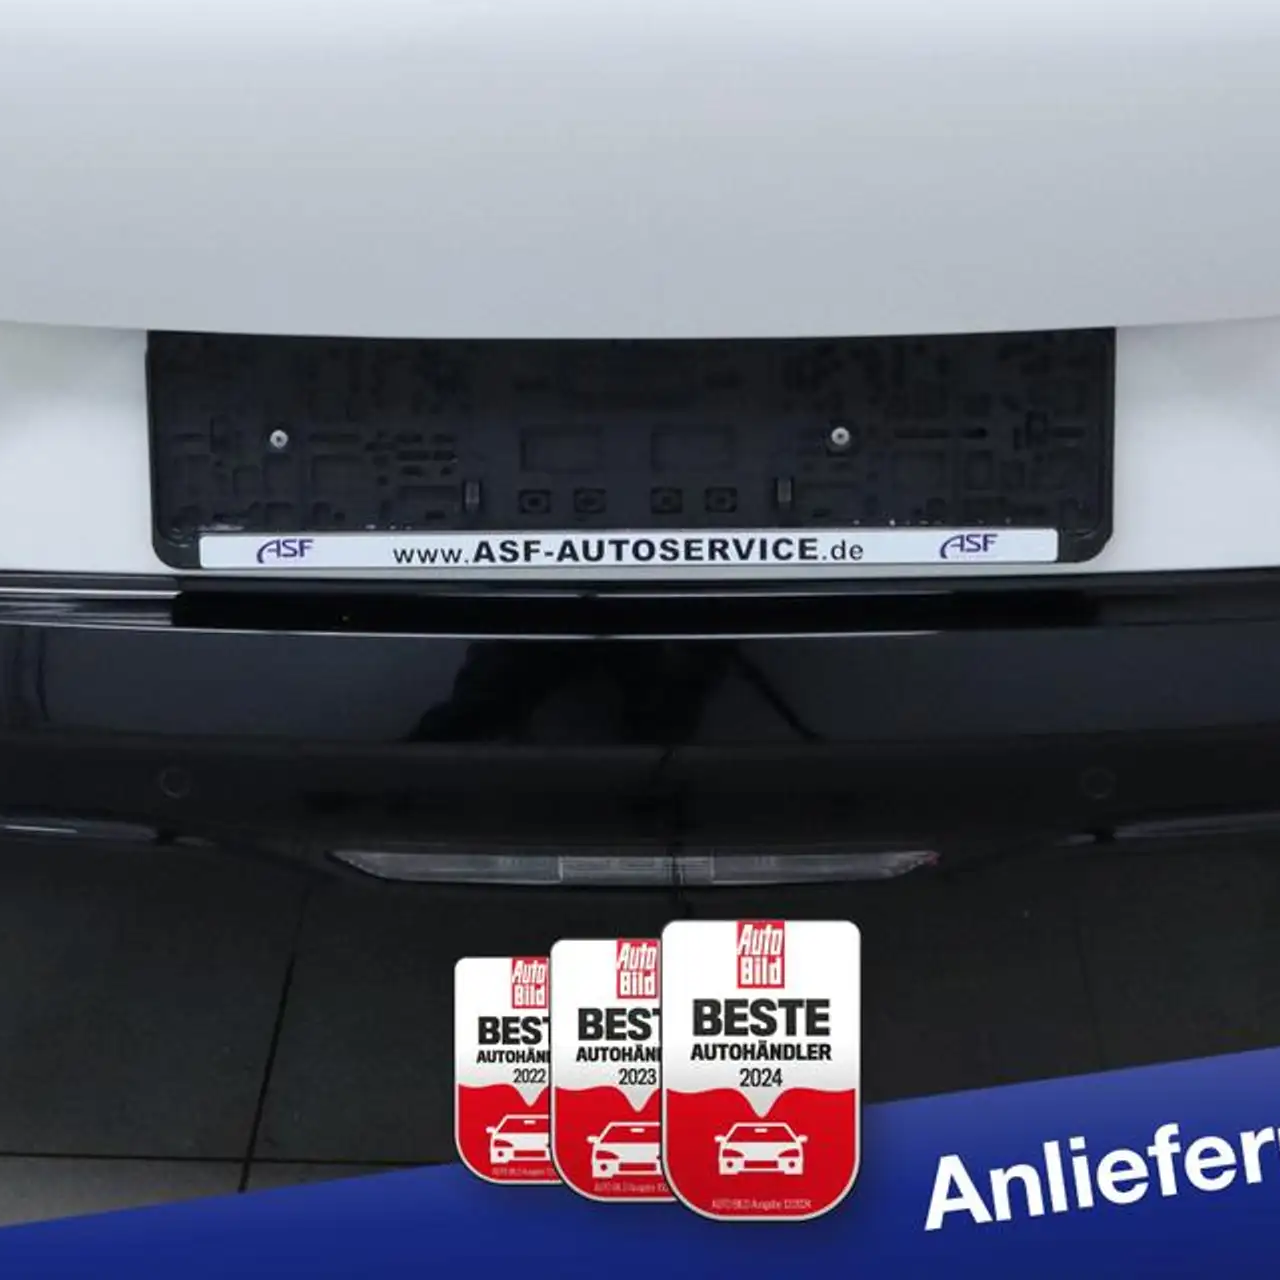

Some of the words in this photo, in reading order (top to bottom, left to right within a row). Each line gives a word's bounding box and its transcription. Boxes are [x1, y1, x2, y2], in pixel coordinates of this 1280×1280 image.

[256, 538, 314, 564] ASF
[392, 537, 864, 565] www.ASF-AUTOSERVICE.de
[939, 533, 998, 559] ASF
